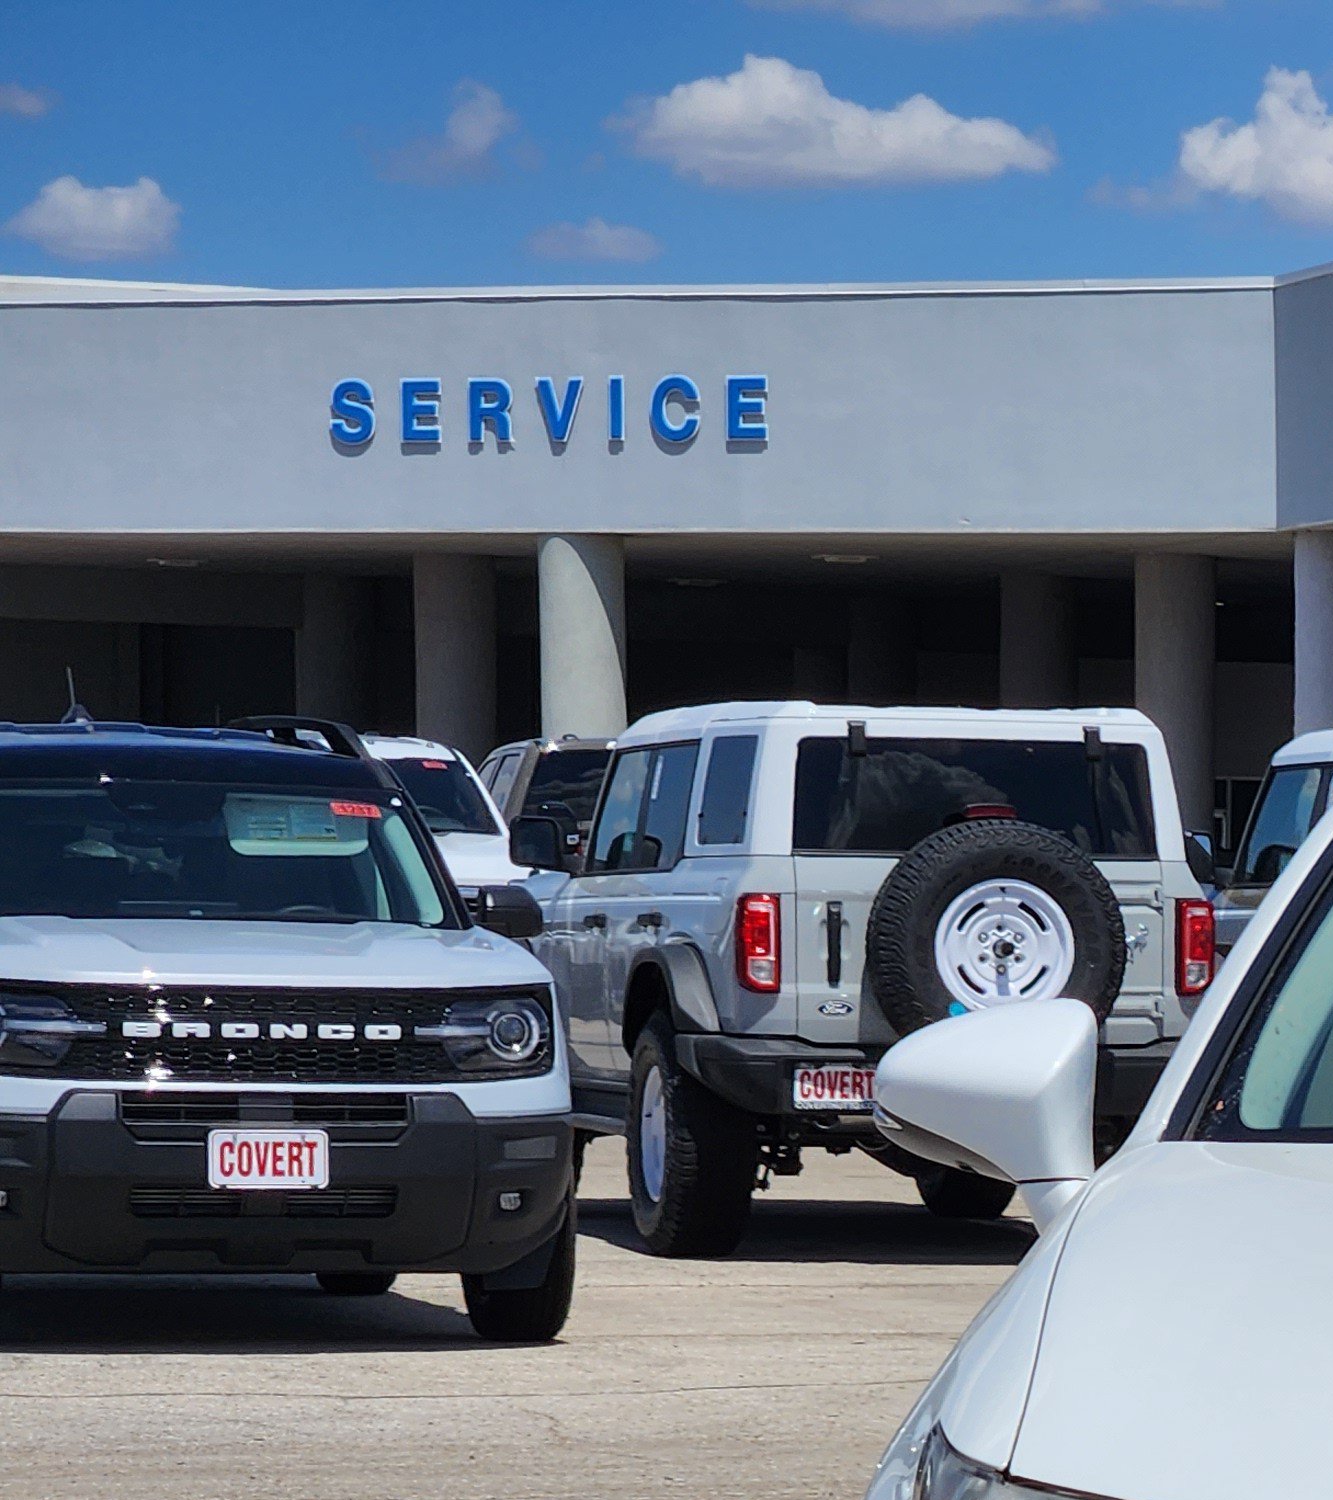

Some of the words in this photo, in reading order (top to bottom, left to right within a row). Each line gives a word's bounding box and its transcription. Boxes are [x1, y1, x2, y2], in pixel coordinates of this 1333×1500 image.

[330, 374, 768, 444] SERVICE
[122, 1021, 402, 1041] BRONCO
[799, 1070, 875, 1099] COVERT
[219, 1140, 318, 1178] COVERT
